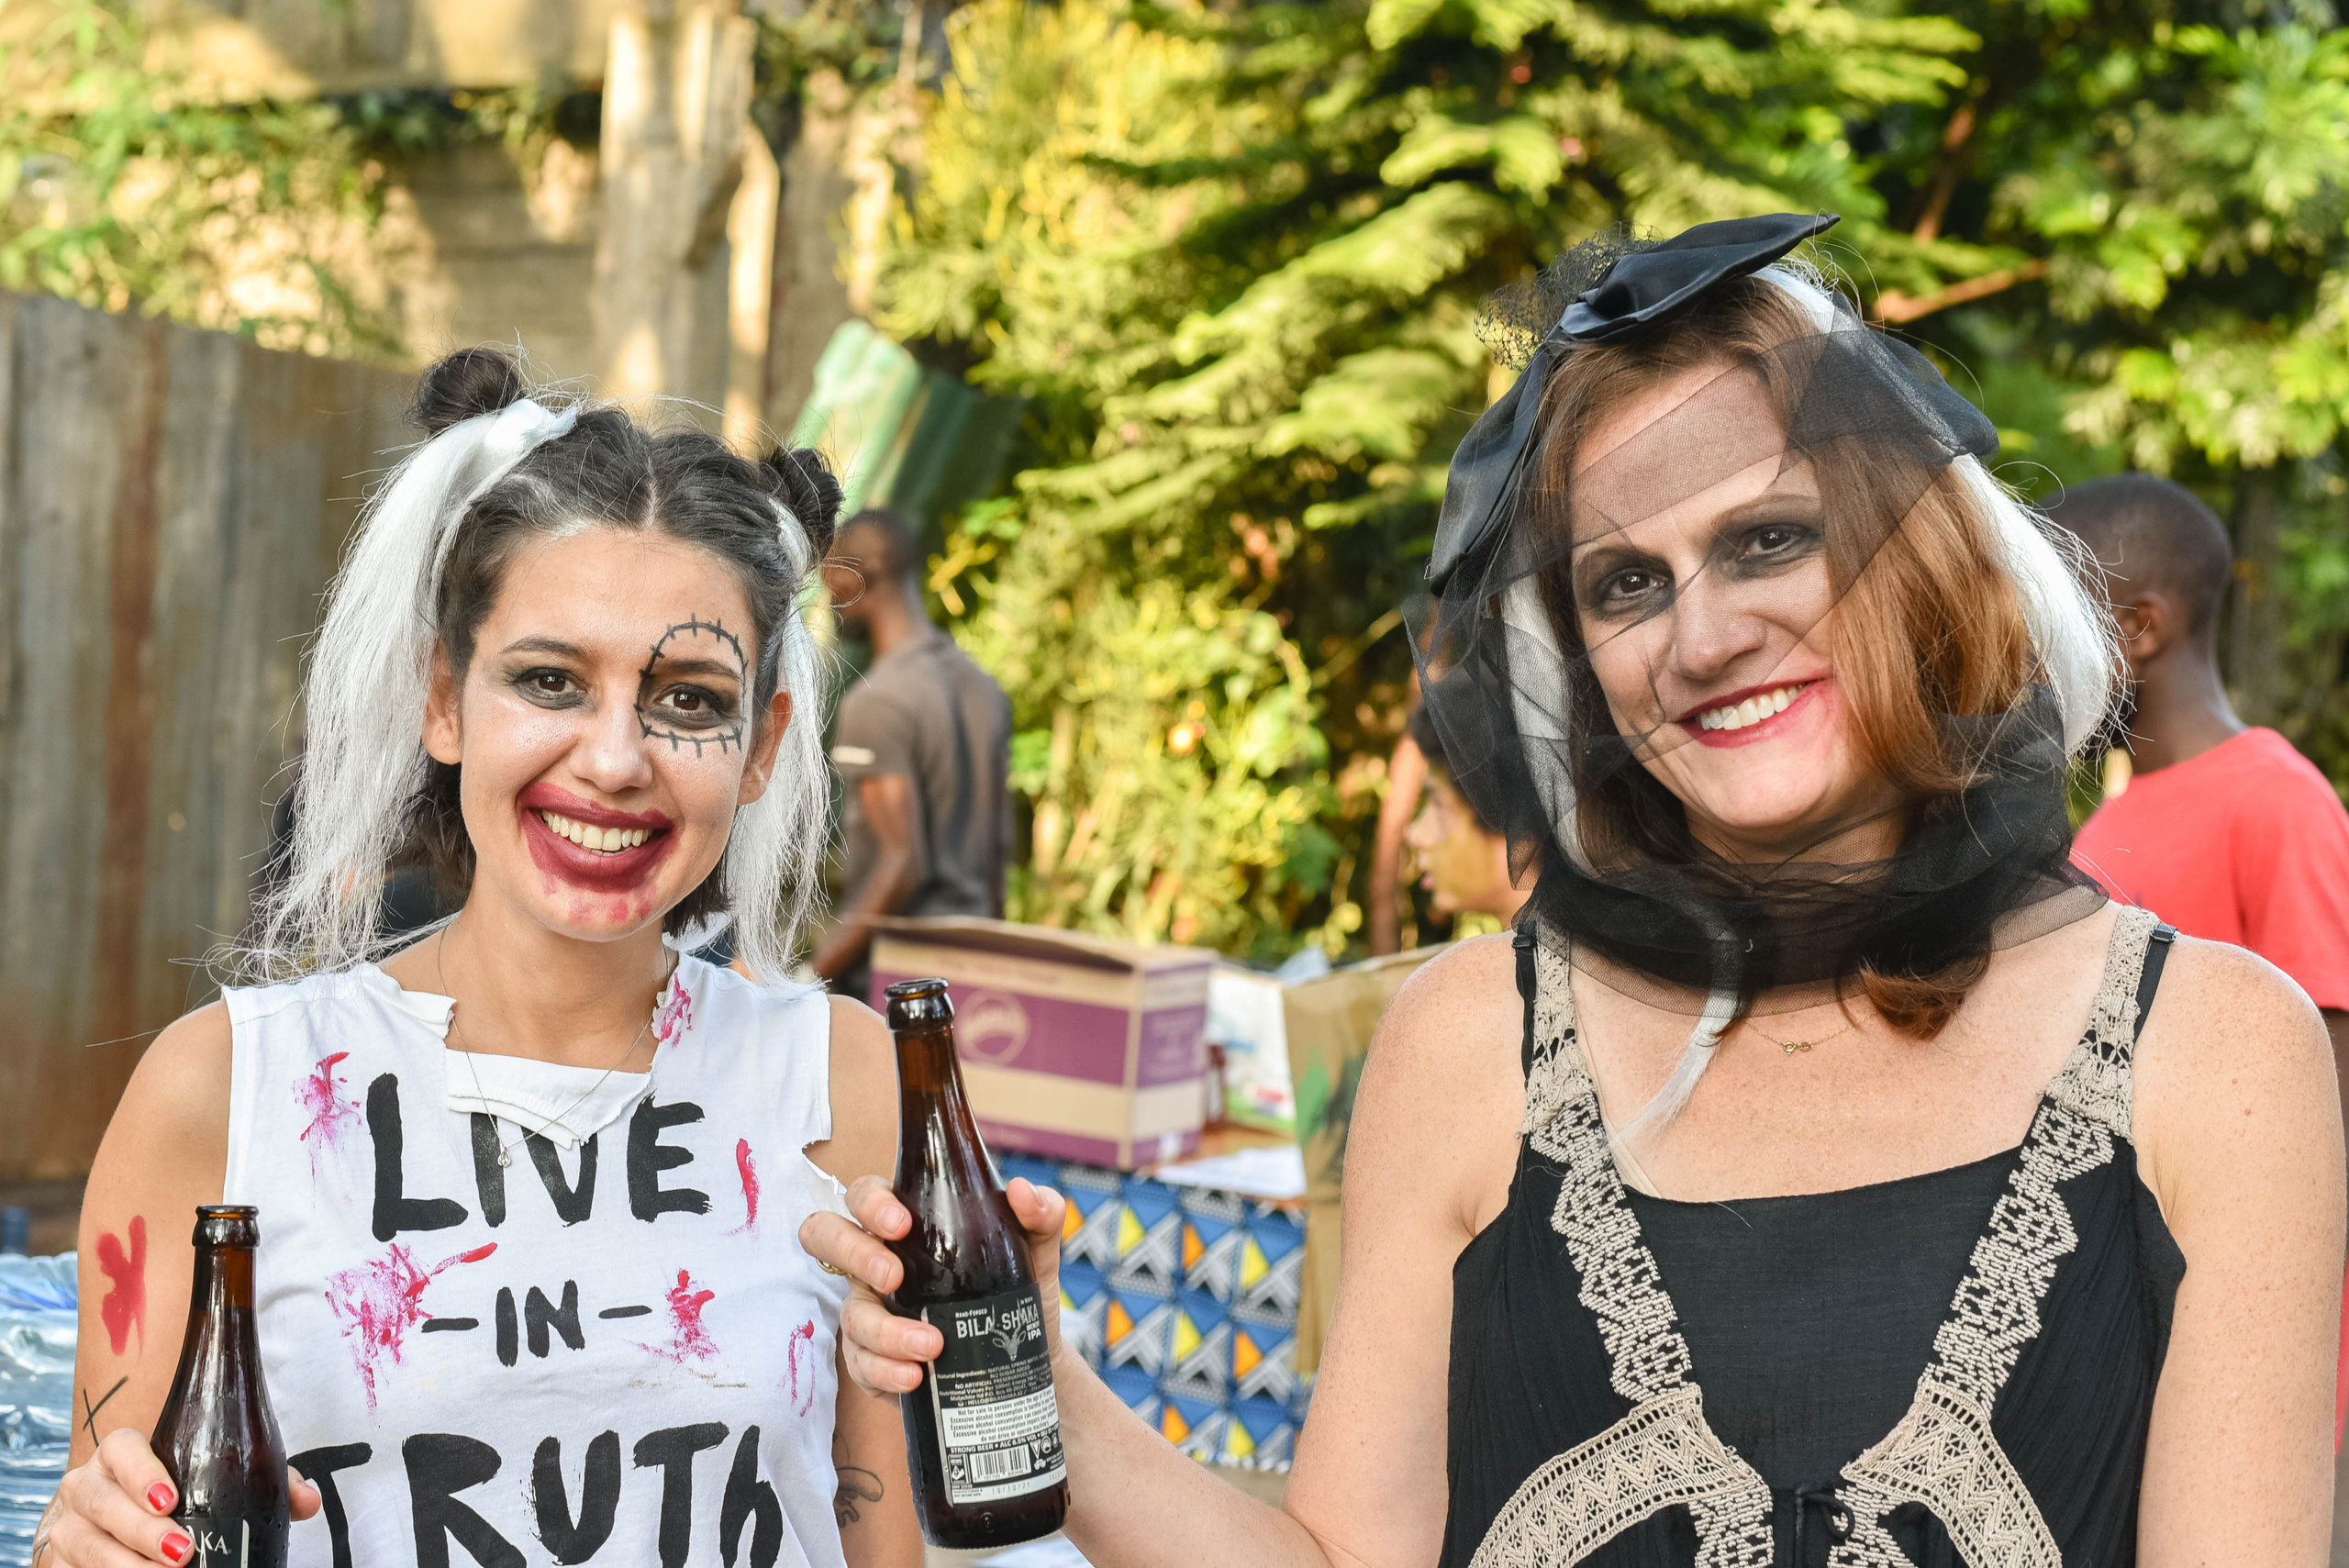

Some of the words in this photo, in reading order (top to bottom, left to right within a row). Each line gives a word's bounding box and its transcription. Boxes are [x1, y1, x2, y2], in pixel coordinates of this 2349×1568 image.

[365, 1072, 713, 1242] LIVE
[956, 1316, 994, 1339] BILA
[1001, 1303, 1040, 1330] SHAKA
[1028, 1328, 1041, 1341] IPA
[964, 1379, 993, 1388] ARTIFICIAL
[994, 1403, 1012, 1412] persons
[1013, 1398, 1026, 1407] under
[950, 1416, 974, 1424] Excessive
[975, 1413, 993, 1421] alcohol
[994, 1407, 1023, 1418] consumption
[950, 1423, 974, 1431] Excessive
[975, 1420, 993, 1429] alcohol
[994, 1414, 1023, 1426] consumption
[978, 1427, 996, 1435] alcohol
[997, 1421, 1026, 1432] consumption
[997, 1431, 1009, 1440] drive
[951, 1446, 976, 1454] STRONG
[977, 1443, 994, 1451] BEER
[999, 1440, 1012, 1449] ALC
[1012, 1437, 1026, 1446] 6.5%
[1026, 1433, 1037, 1441] VOL
